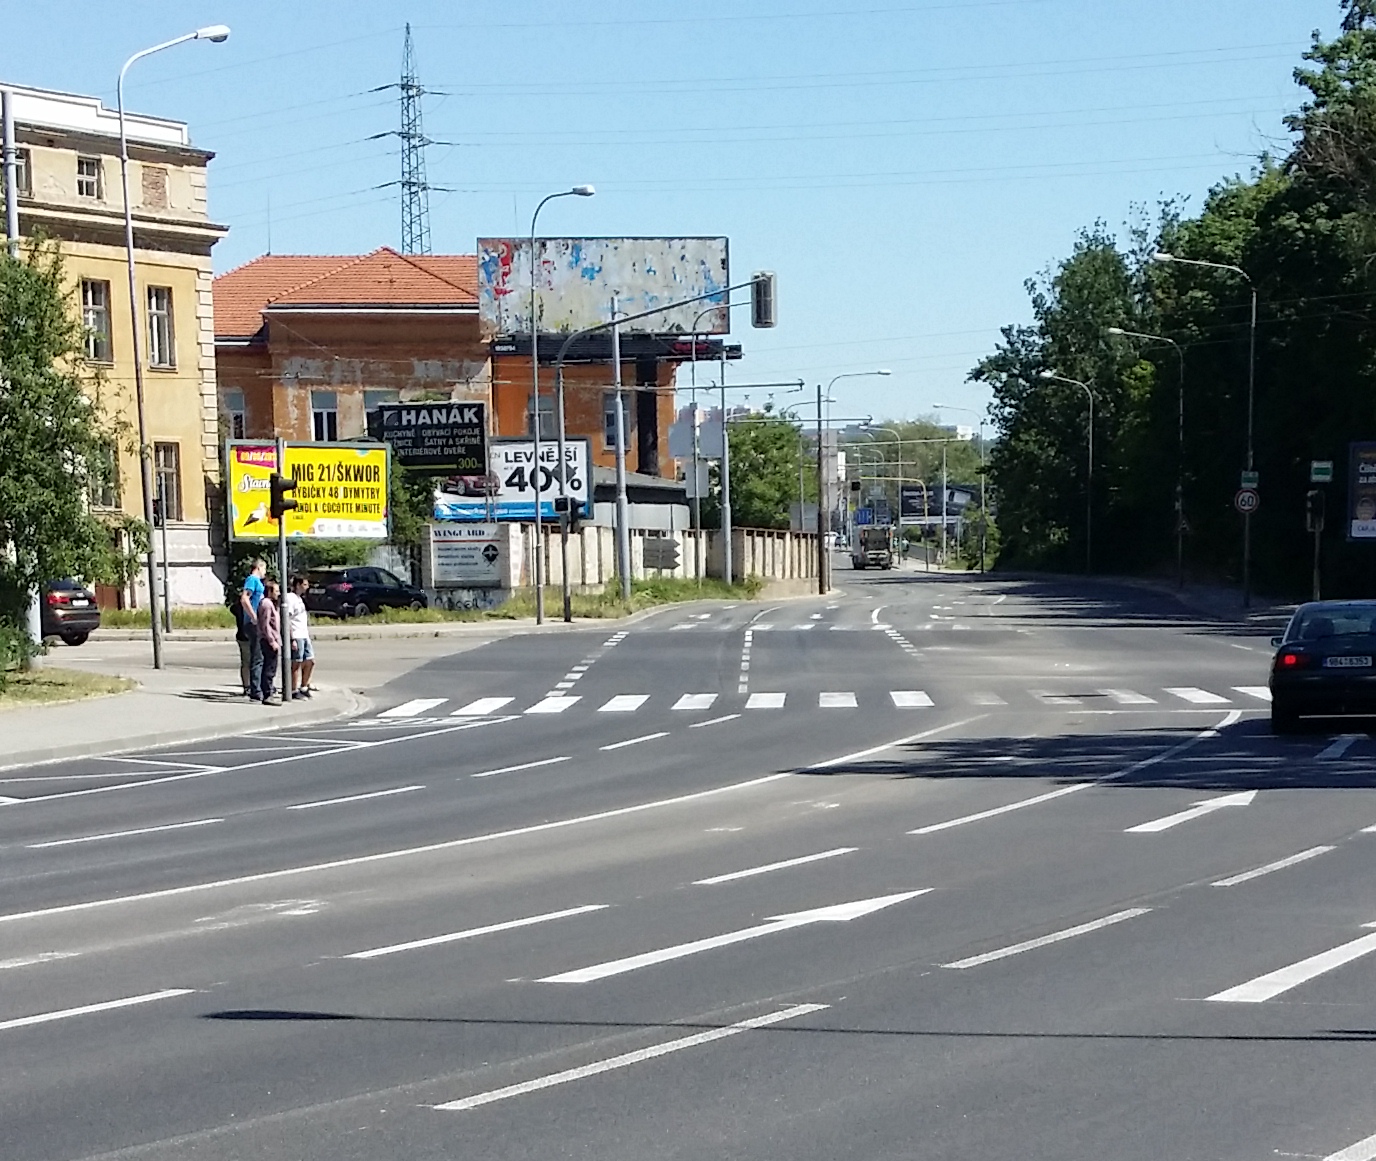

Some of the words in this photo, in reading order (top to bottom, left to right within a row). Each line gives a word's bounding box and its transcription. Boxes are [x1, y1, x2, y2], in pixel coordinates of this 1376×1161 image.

[401, 405, 480, 426] HANÁK
[453, 427, 481, 436] POKOJE
[448, 437, 454, 445] A
[504, 447, 577, 463] LEVNĚŠÍ
[291, 463, 314, 482] MIG
[317, 461, 380, 483] 21/ŠKWOR
[291, 484, 326, 499] RYBIČKY
[328, 486, 339, 499] 48
[343, 487, 380, 500] DYMYTRY
[1240, 495, 1254, 507] 60
[322, 503, 353, 514] COCOTTE
[355, 503, 380, 514] MINUTE
